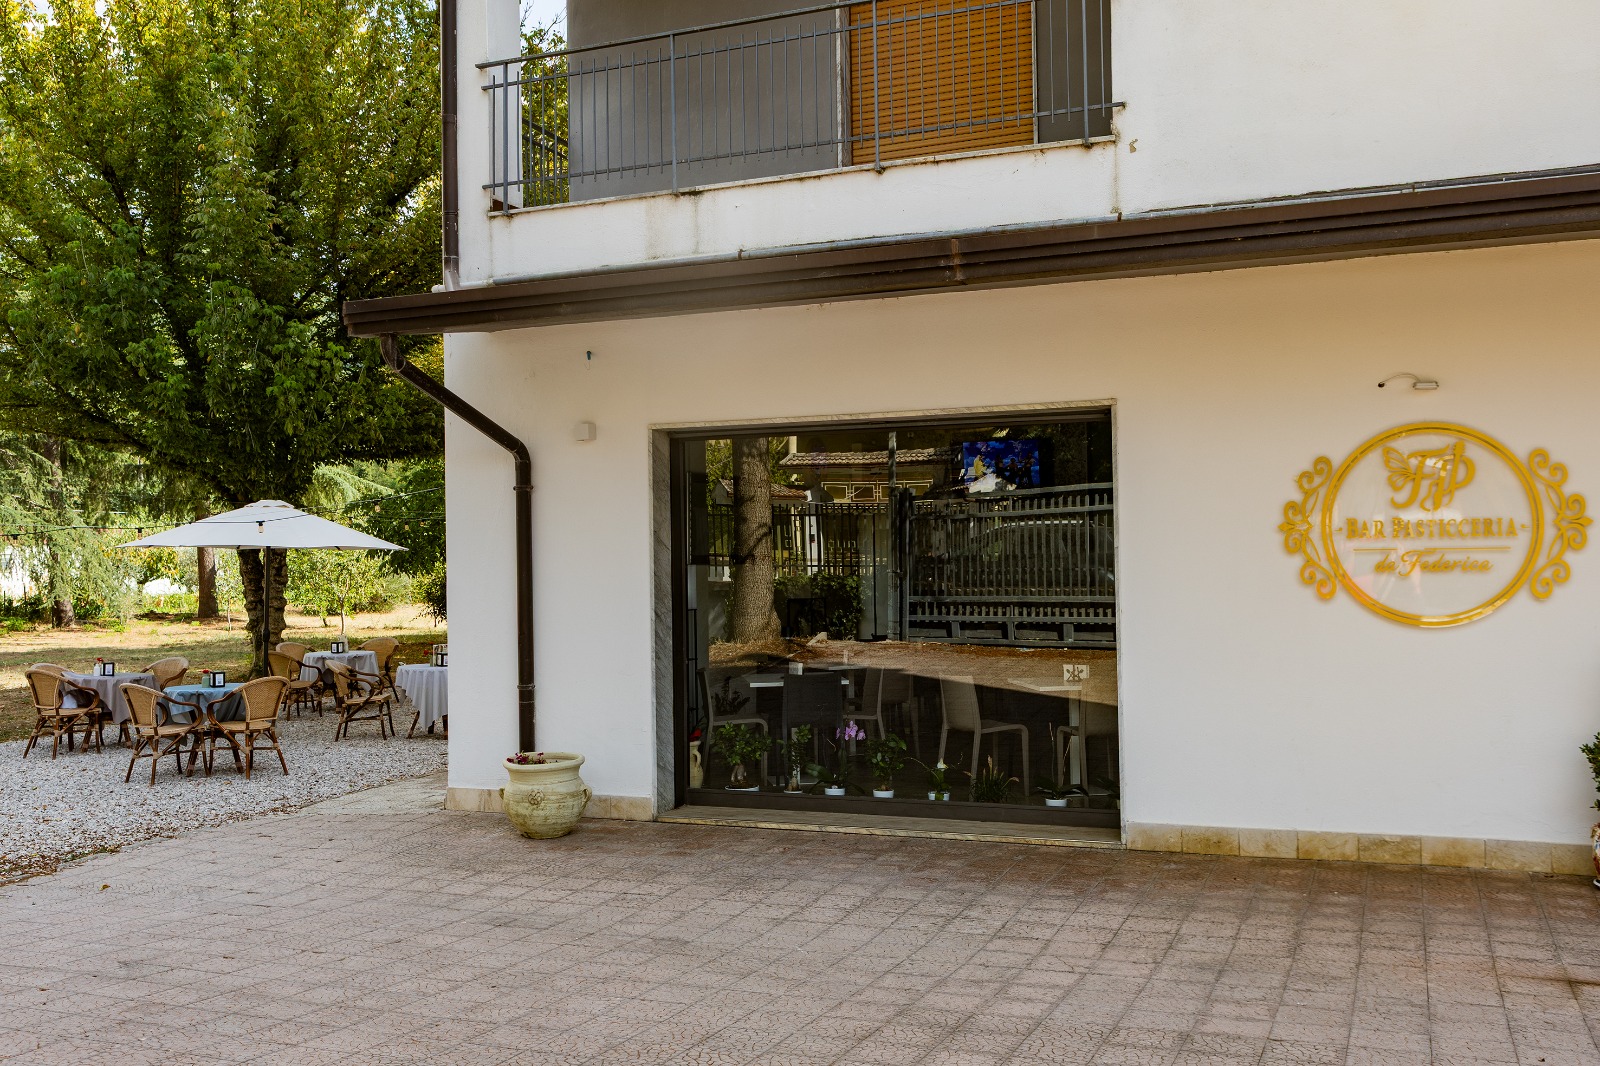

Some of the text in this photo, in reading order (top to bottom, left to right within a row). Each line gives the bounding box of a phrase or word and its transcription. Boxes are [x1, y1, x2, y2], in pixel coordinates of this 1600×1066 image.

[1346, 517, 1518, 539] BAR PASTICCERIA
[1374, 549, 1494, 577] da Federica
